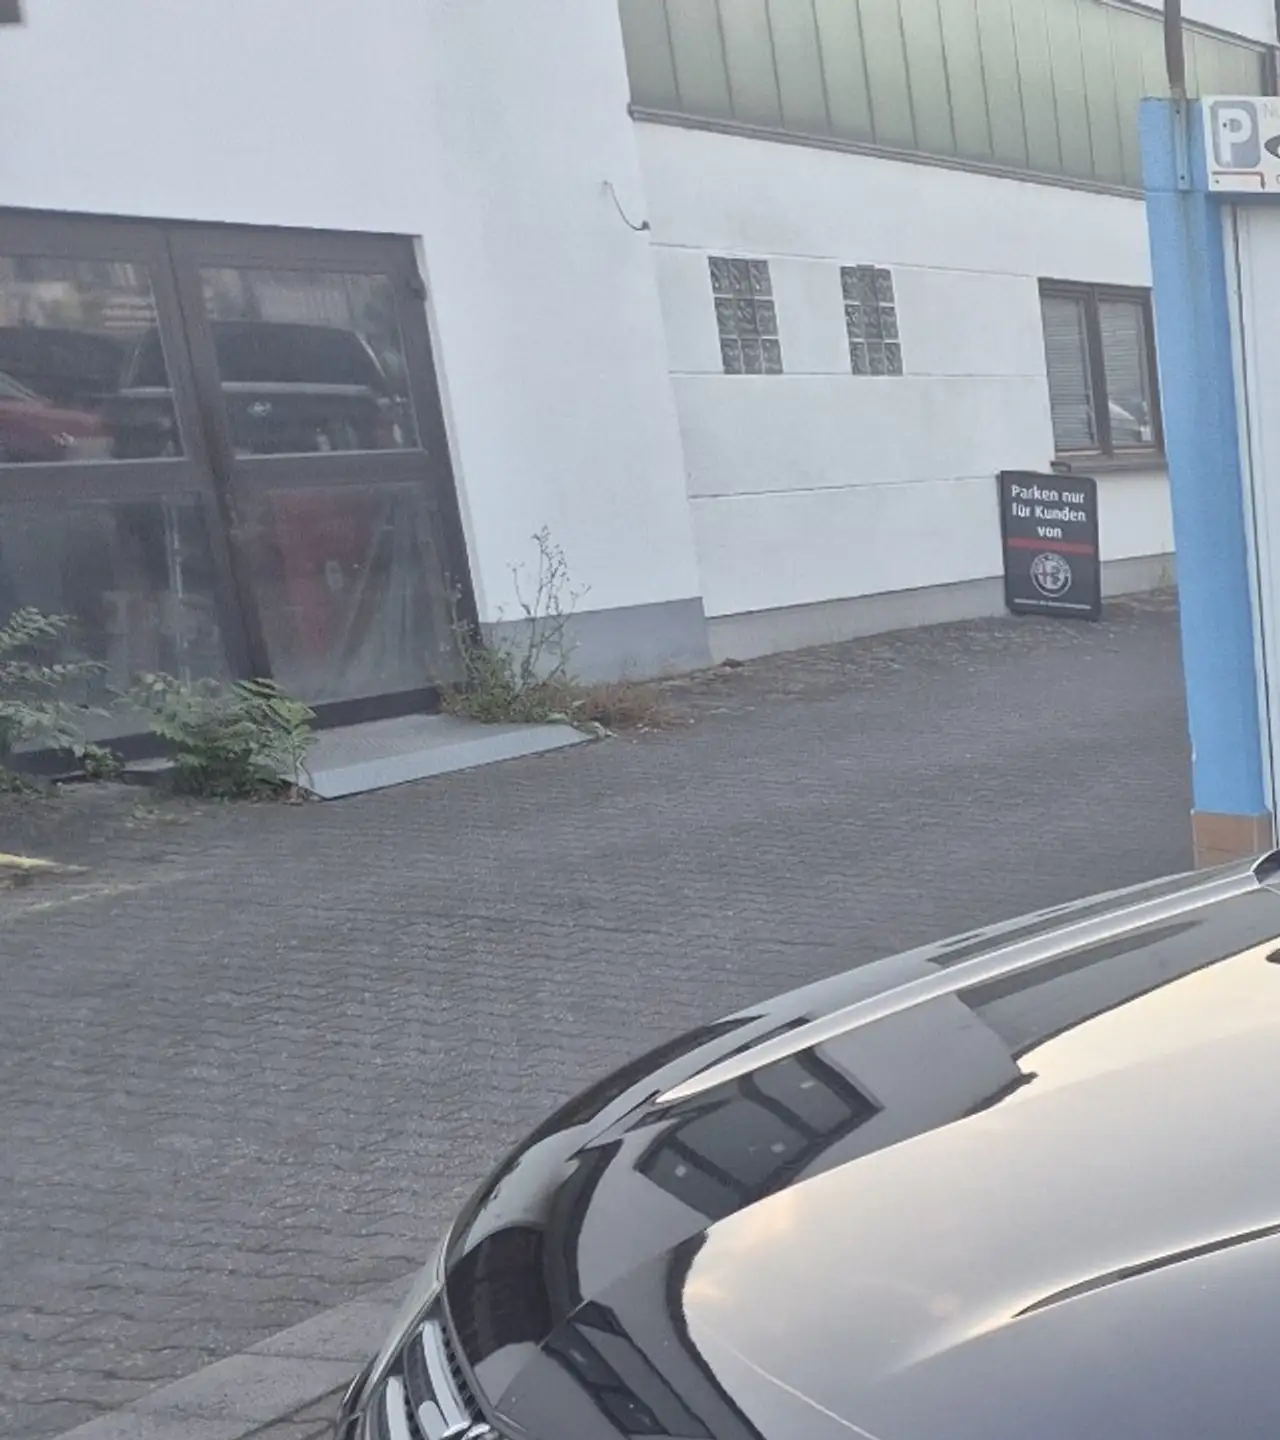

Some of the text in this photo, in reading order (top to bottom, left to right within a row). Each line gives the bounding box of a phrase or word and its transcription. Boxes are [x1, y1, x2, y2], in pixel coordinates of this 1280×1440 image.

[1011, 484, 1086, 504] Parken nur
[1011, 502, 1087, 522] für Kunden
[1037, 525, 1063, 540] von
